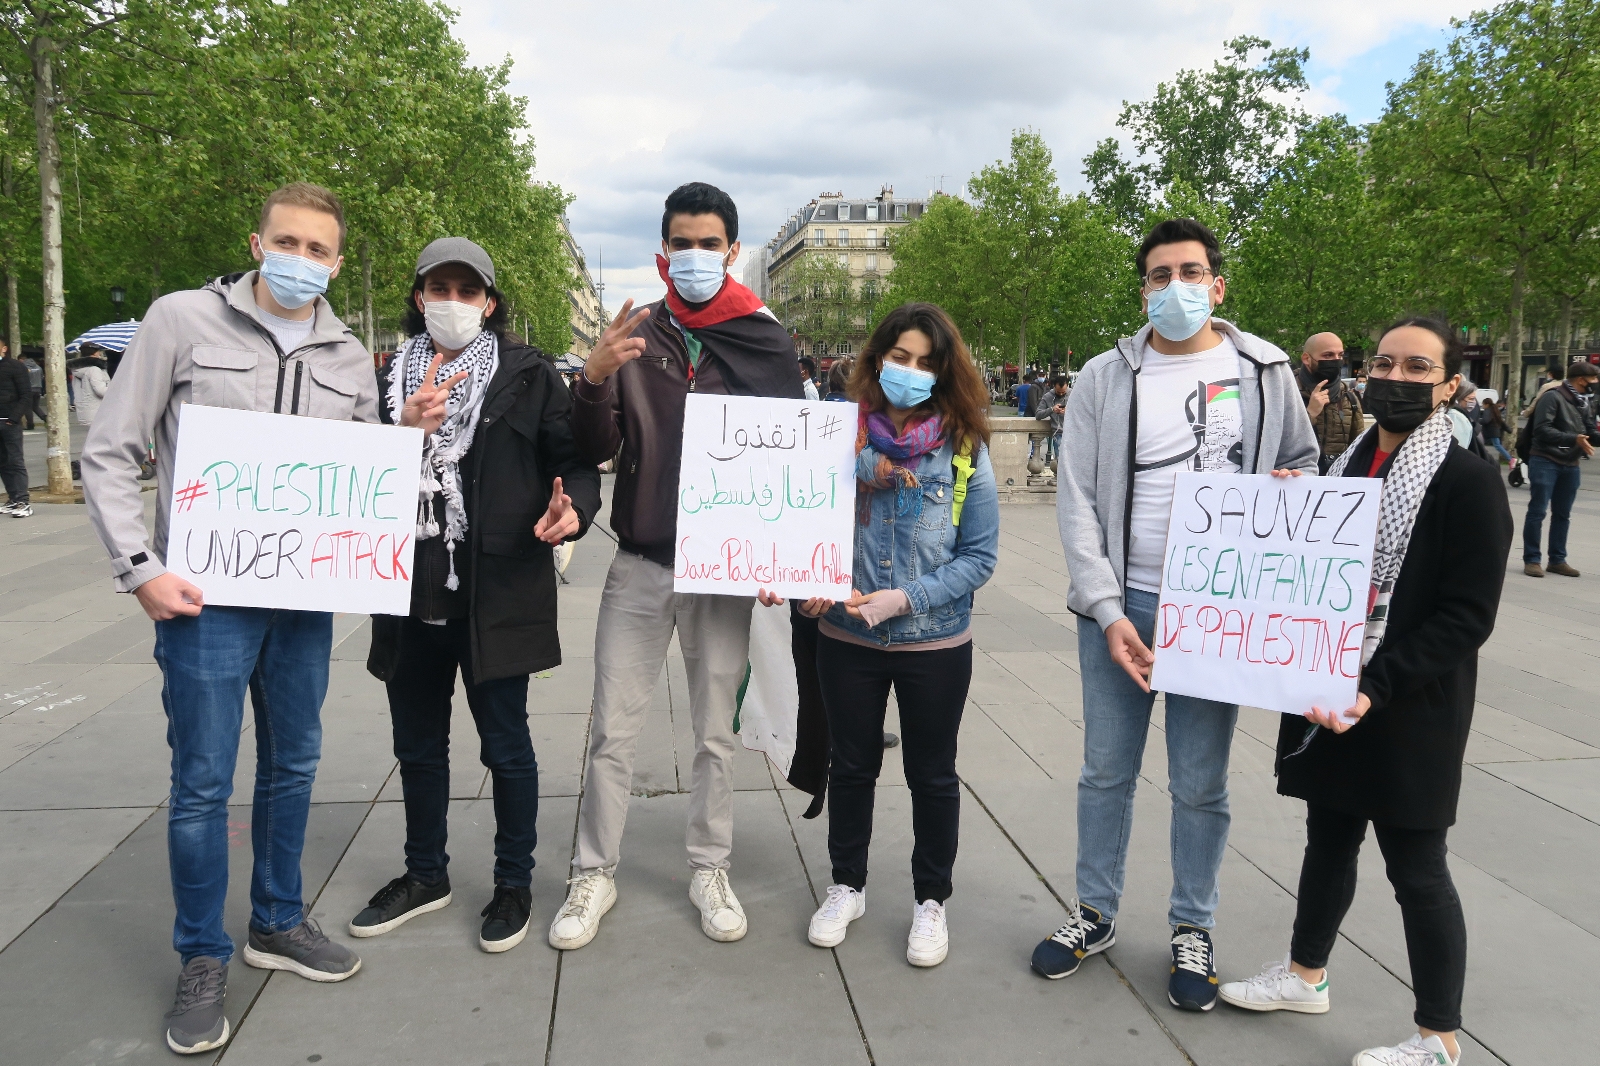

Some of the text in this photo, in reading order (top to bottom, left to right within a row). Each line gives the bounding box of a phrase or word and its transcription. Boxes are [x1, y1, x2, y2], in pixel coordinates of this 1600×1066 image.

[175, 460, 399, 520] #PALESTINE
[681, 464, 838, 522] أطفال فلسطين
[1184, 485, 1366, 547] SAUVEZ
[185, 527, 410, 582] UNDER ATTACK
[674, 535, 722, 580] Save
[720, 537, 810, 584] Palestinian
[1196, 605, 1365, 679] PALESTINE
